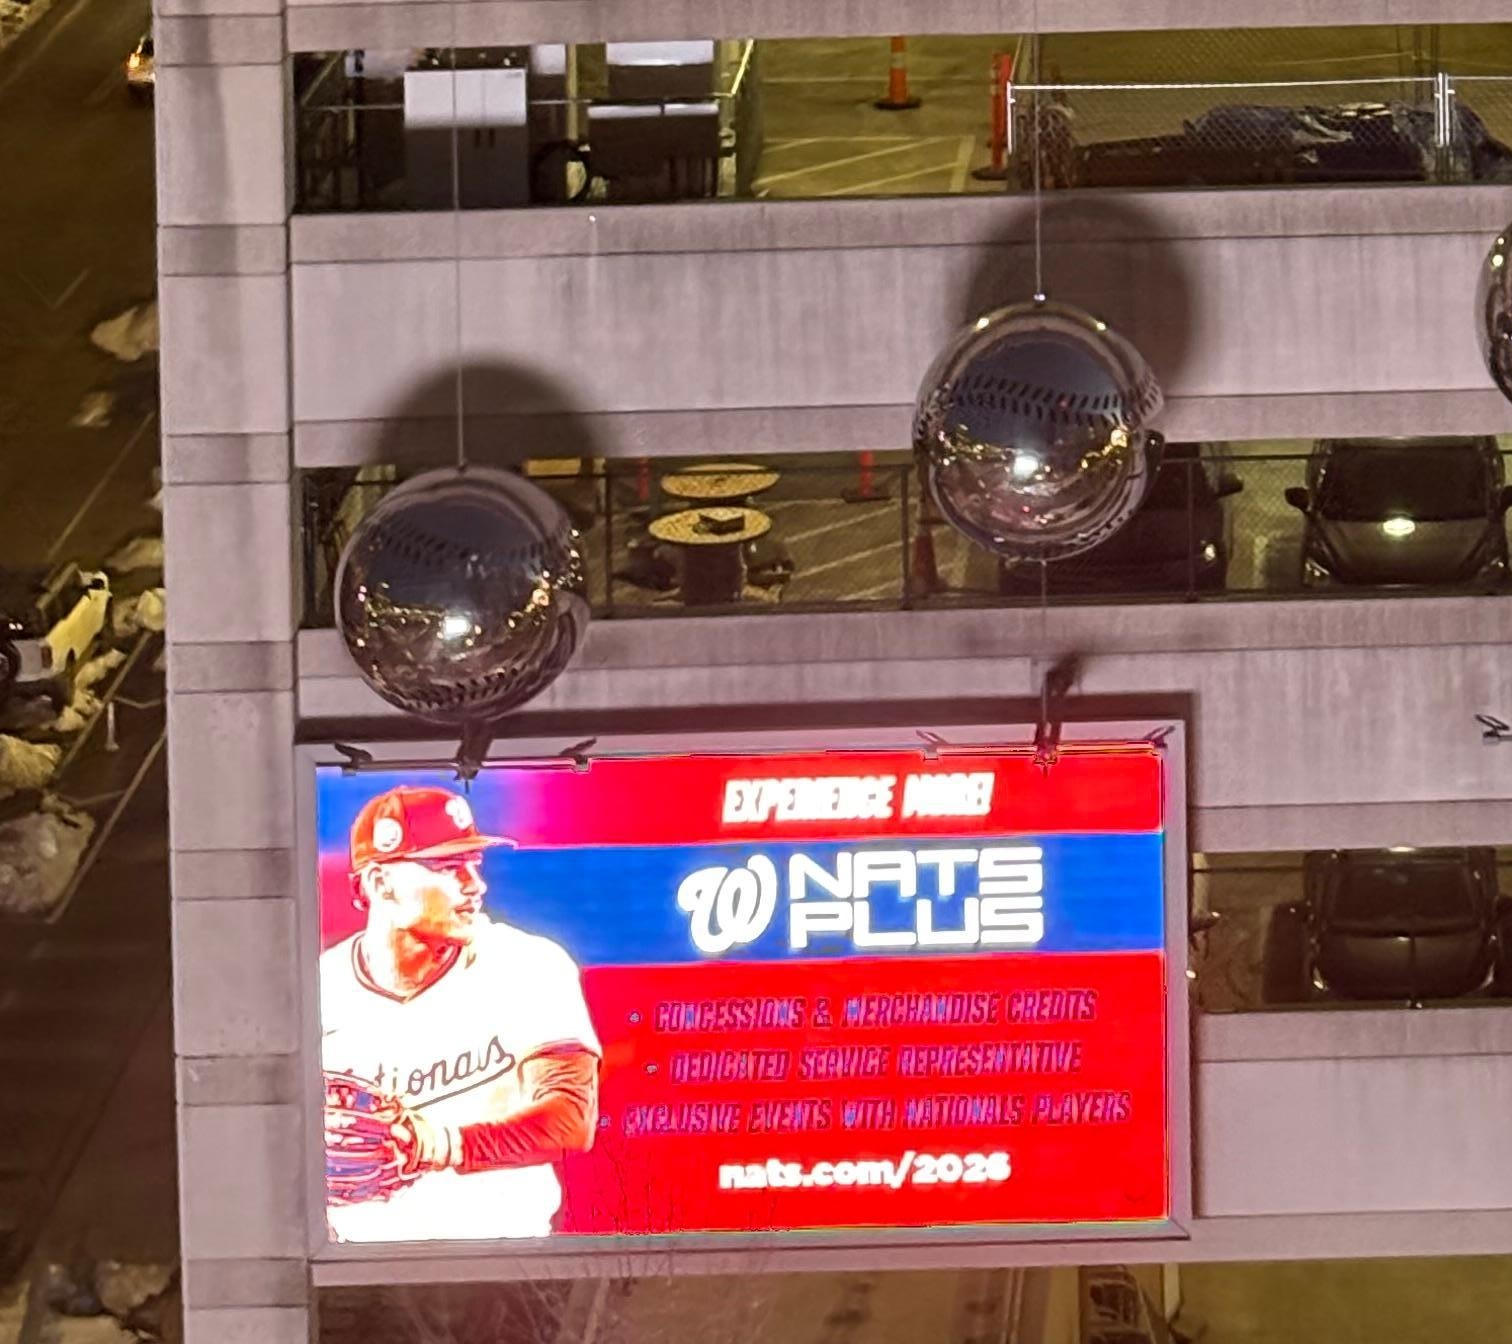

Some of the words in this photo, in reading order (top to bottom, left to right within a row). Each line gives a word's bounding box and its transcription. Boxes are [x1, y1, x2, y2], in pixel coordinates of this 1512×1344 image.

[789, 847, 1043, 899] NATS
[677, 855, 777, 952] W
[789, 896, 1044, 949] PLUS
[654, 999, 806, 1033] CONCESSIONS
[813, 998, 832, 1028] &
[841, 993, 1000, 1030] MERCHANDISE
[1006, 990, 1098, 1024] CREDITS
[670, 1050, 791, 1083] DEDICATED
[799, 1046, 891, 1080] SERVICE
[896, 1042, 1082, 1078] REPRESENTATIVE
[623, 1102, 742, 1135] EXCLUSIVE
[747, 1099, 832, 1133] EVENTS
[841, 1098, 896, 1130] WITH
[901, 1093, 1026, 1128] NATIONALS
[1031, 1089, 1131, 1125] PLAYERS
[718, 1152, 1012, 1189] nats.com/2026
